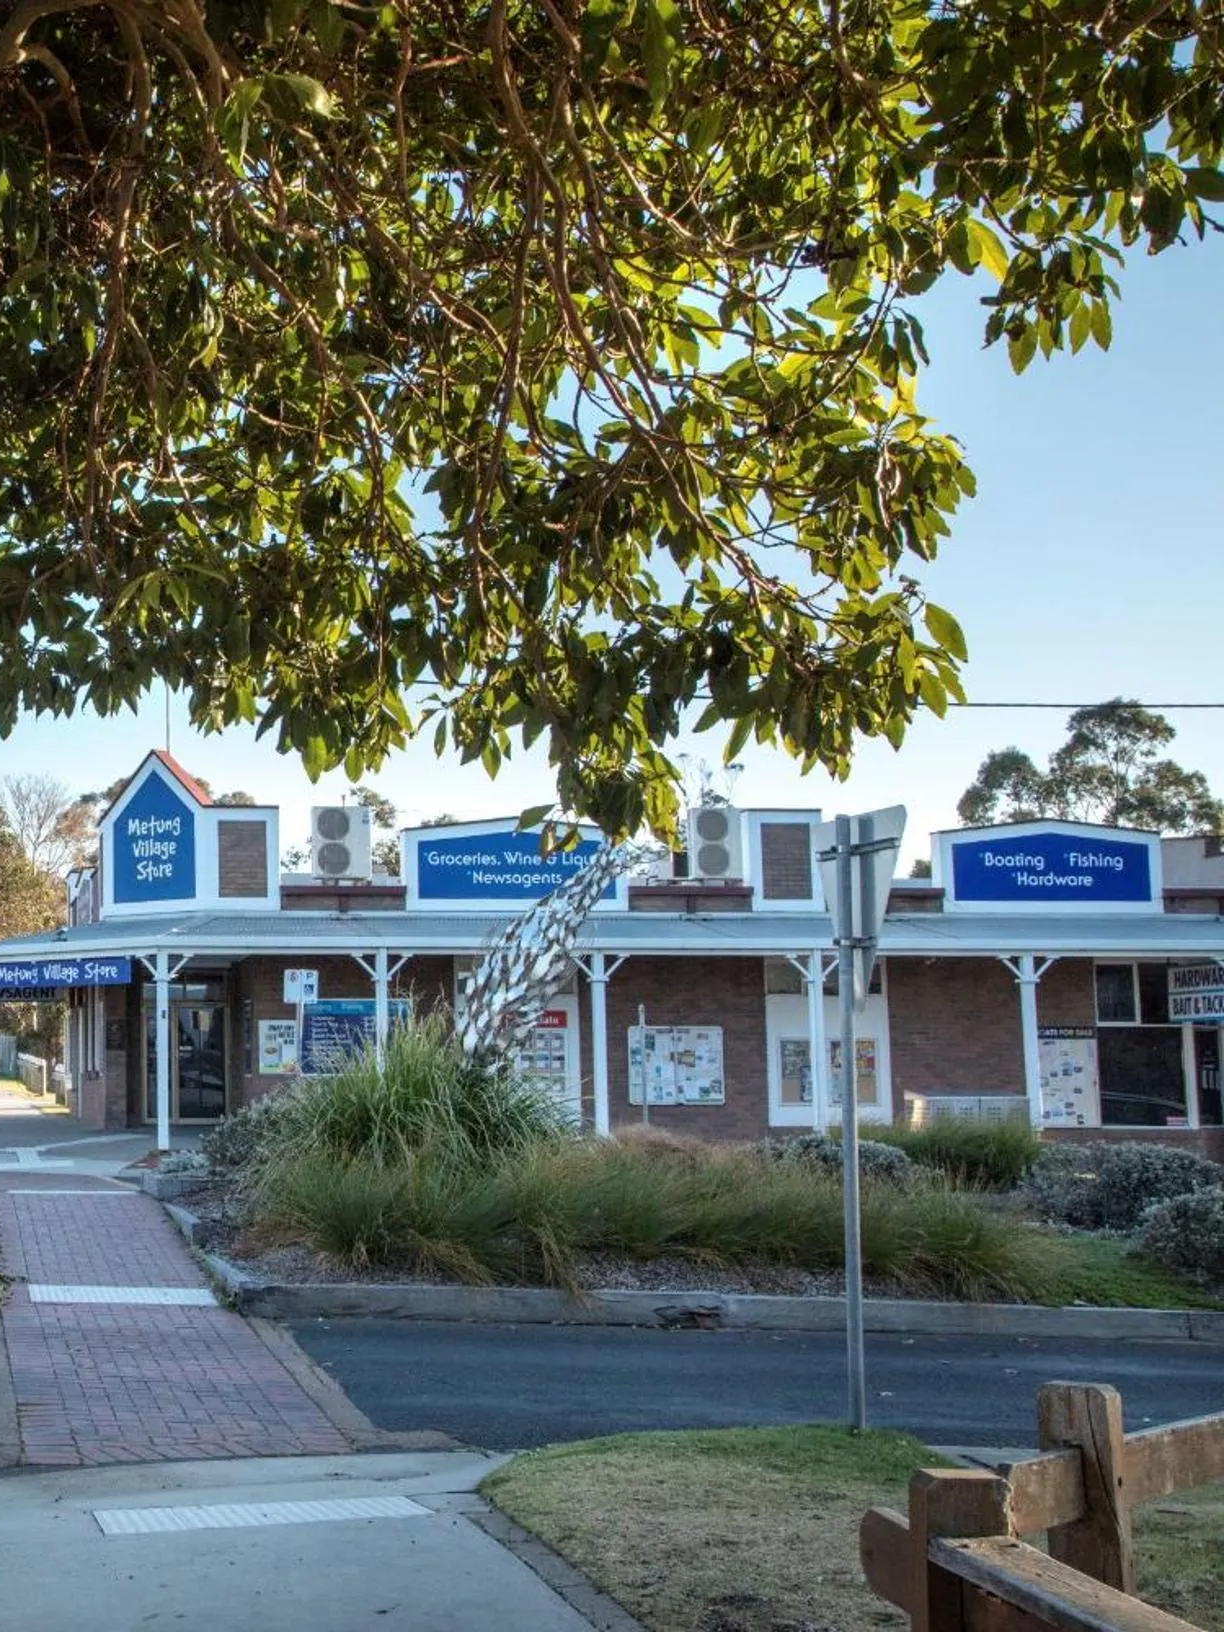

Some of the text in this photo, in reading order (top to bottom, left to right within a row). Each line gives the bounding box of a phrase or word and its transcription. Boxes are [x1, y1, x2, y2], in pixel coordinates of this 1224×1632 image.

[128, 815, 180, 836] Metung
[132, 839, 176, 859] Village
[503, 851, 541, 865] Wine
[562, 851, 593, 869] Liqu
[985, 852, 1124, 870] Boating Fishing
[136, 861, 172, 882] Store
[472, 870, 563, 887] Newsagents
[1017, 872, 1093, 887] Hardware
[43, 964, 79, 983] Village
[84, 962, 118, 982] Store
